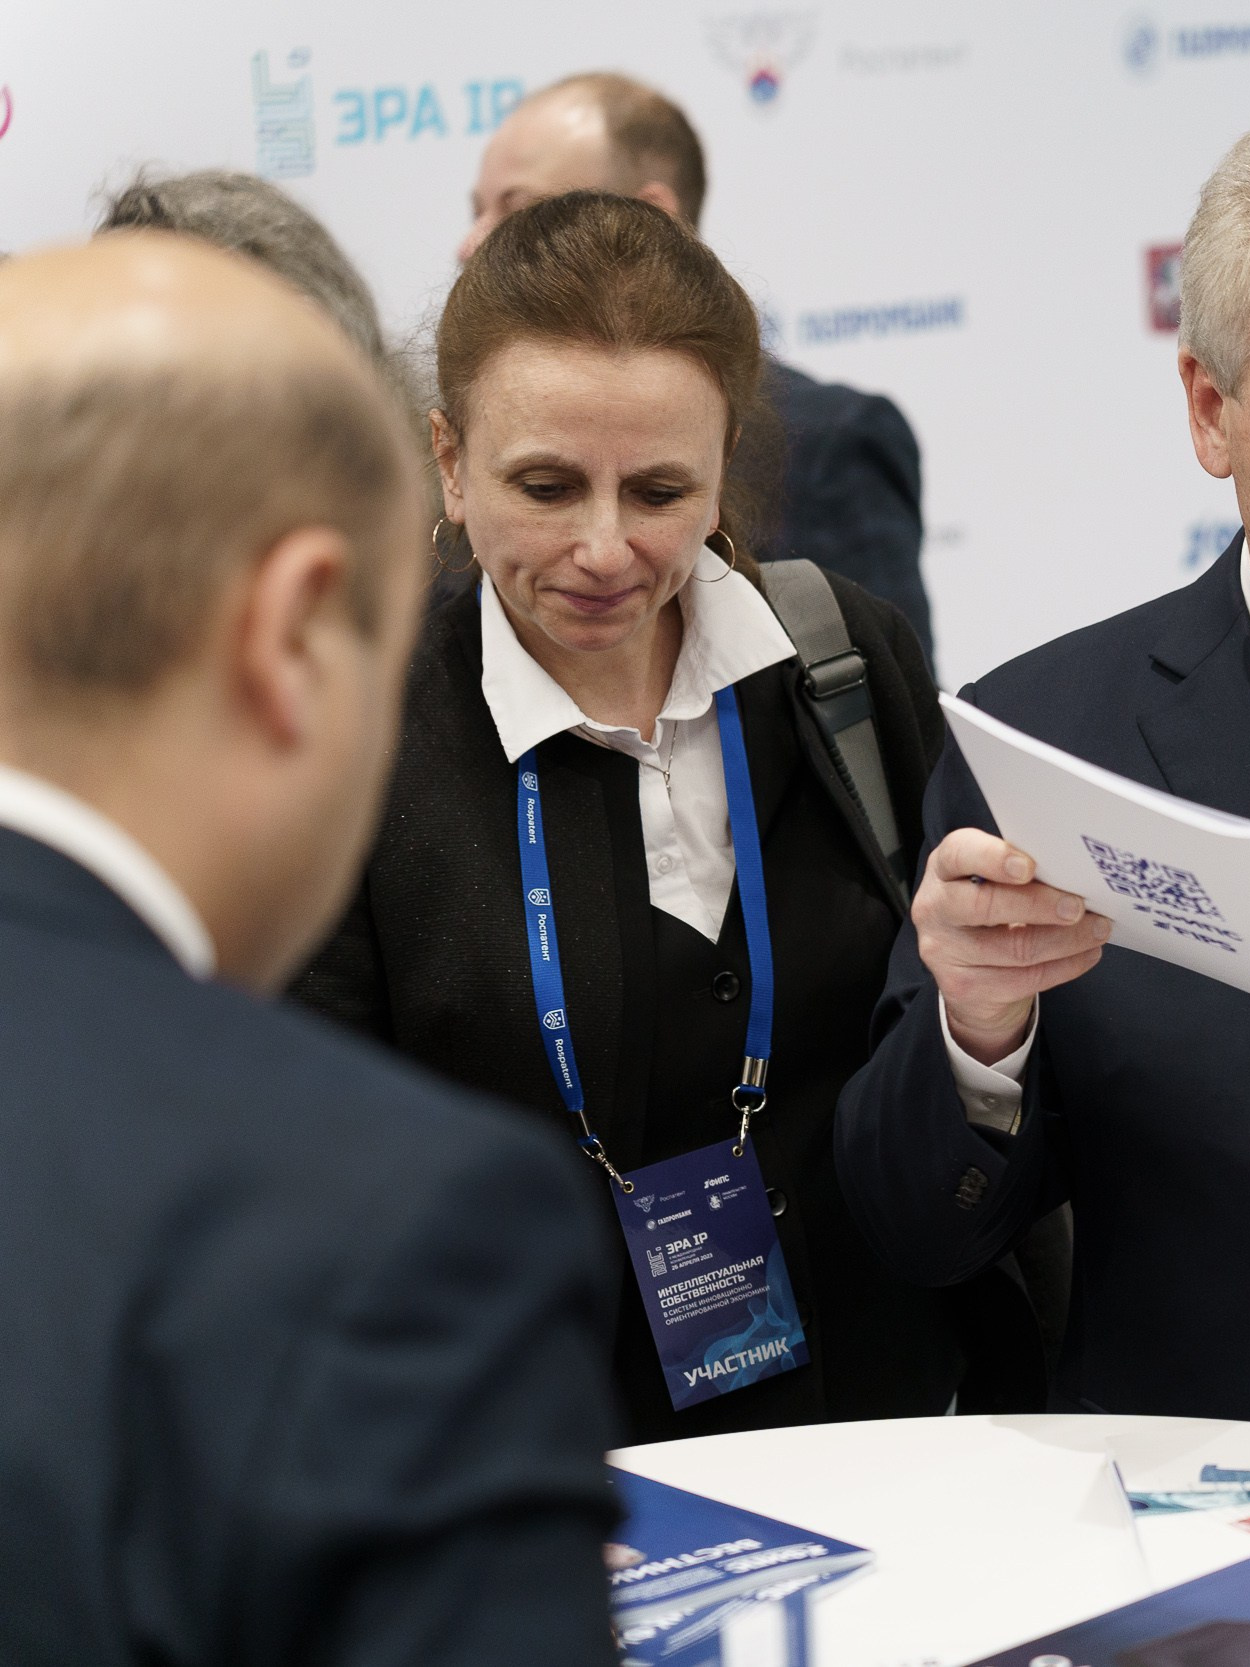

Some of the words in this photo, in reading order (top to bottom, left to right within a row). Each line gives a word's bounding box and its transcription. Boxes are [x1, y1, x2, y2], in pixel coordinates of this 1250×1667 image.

[334, 82, 446, 143] ЭРА
[527, 797, 537, 844] Rospatent
[537, 913, 551, 962] Роспатент
[554, 1038, 573, 1089] Rospatent
[708, 1174, 730, 1188] ФИПС
[665, 1238, 692, 1255] ЭРА
[692, 1231, 708, 1246] IP
[679, 1257, 700, 1268] АПРЕЛЯ
[657, 1255, 765, 1298] ИНТЕЛЛЕКТУАЛЬНАЯ
[660, 1274, 746, 1309] СОБСТВЕННОСТЬ
[665, 1298, 730, 1326] ОРИЕНТИРОВАННОЙ
[730, 1284, 771, 1304] ЭКОНОМИКИ
[668, 1303, 698, 1316] СИСТЕМЕ
[699, 1282, 753, 1306] ИННОВАЦИОННО
[683, 1336, 790, 1388] УЧАСТНИК
